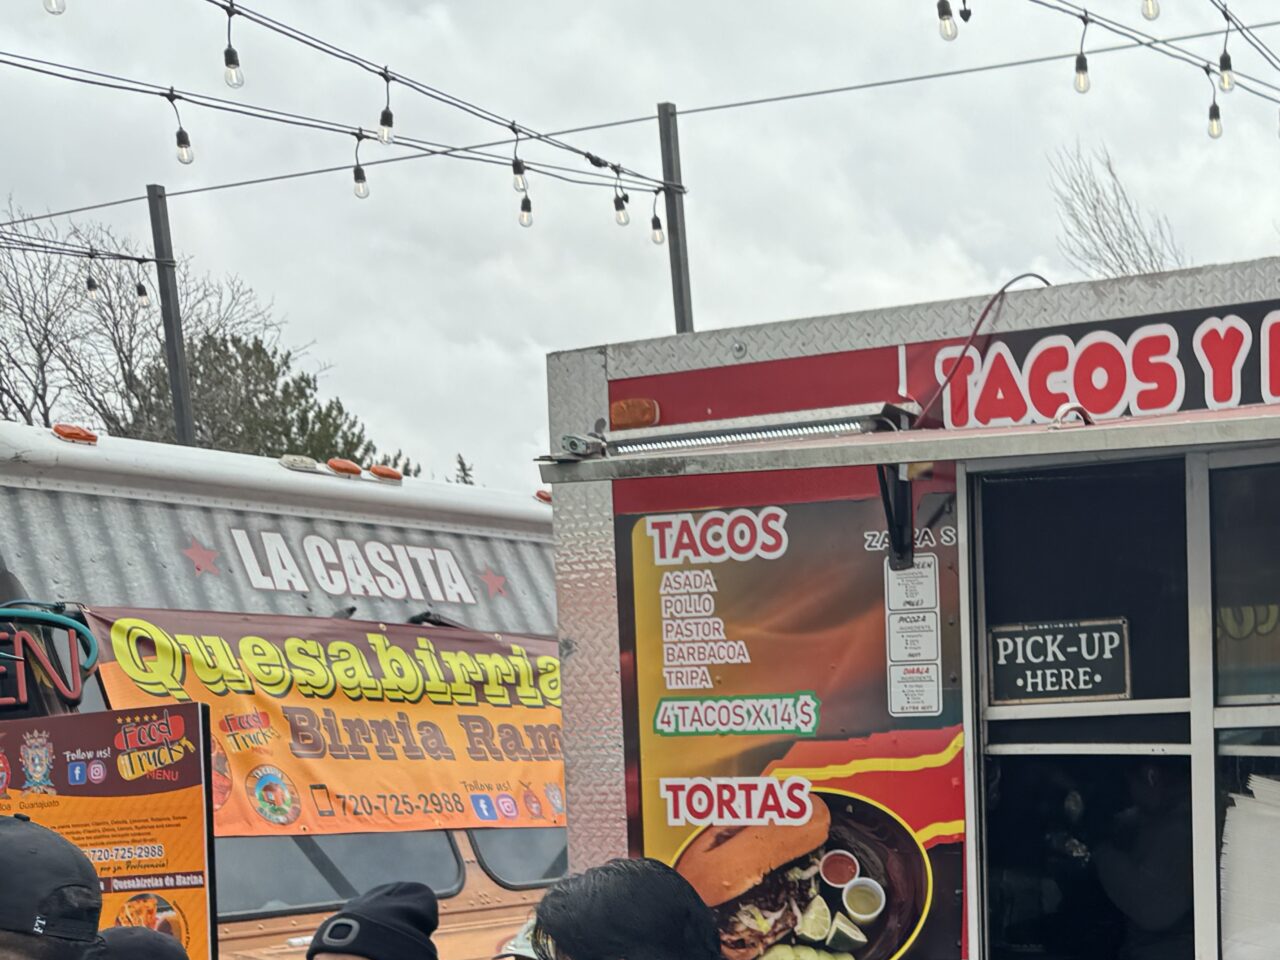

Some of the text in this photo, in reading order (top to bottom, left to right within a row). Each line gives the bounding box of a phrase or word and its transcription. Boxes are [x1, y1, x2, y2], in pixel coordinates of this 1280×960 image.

[938, 328, 1182, 430] TACOS
[1196, 318, 1250, 409] Y
[648, 508, 787, 563] TACOS
[231, 529, 476, 603] LA CASITA
[662, 572, 715, 592] ASADA
[663, 596, 714, 616] POLLO
[664, 619, 723, 639] PASTOR
[665, 643, 747, 662] BARBACOA
[996, 631, 1121, 665] PICK-UP
[110, 617, 561, 706] Quesabirria
[665, 668, 711, 688] TRIPA
[1025, 667, 1093, 692] HERE
[660, 700, 814, 729] 4 TACOS X 14 $
[122, 709, 172, 750] Food
[281, 706, 456, 761] Birria
[63, 747, 94, 762] Follow
[146, 768, 179, 781] MENU
[460, 780, 493, 792] Follow
[336, 793, 465, 817] 720-725-2988
[660, 780, 812, 824] TORTAS
[90, 845, 164, 861] 720-725-2988
